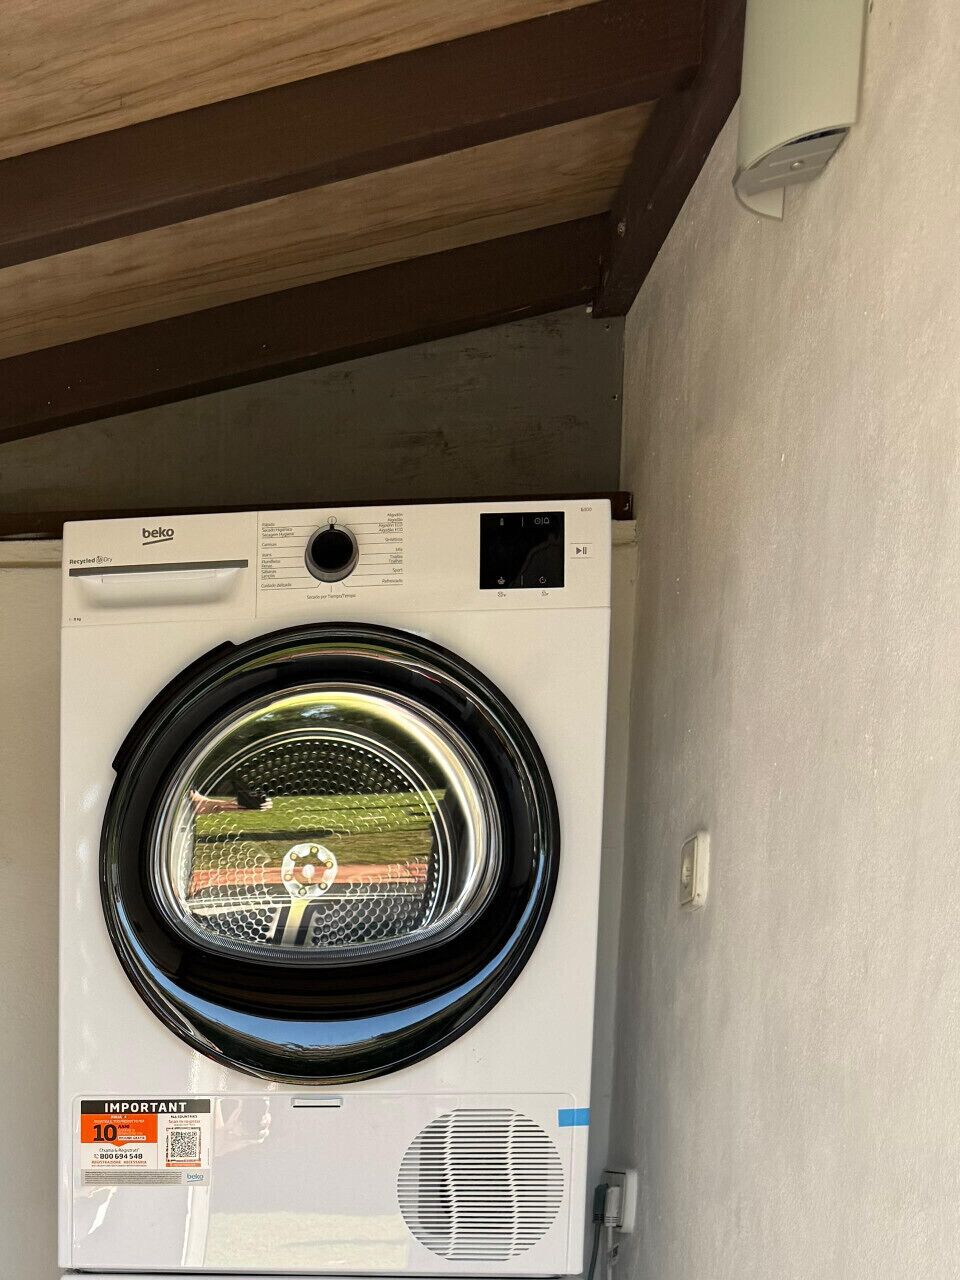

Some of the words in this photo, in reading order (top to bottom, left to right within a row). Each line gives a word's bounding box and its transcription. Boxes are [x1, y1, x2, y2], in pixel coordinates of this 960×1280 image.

[142, 527, 175, 539] beko
[69, 557, 96, 566] Recycled
[103, 556, 113, 564] Dry
[104, 1102, 187, 1113] IMPORTANT
[93, 1123, 118, 1142] 10
